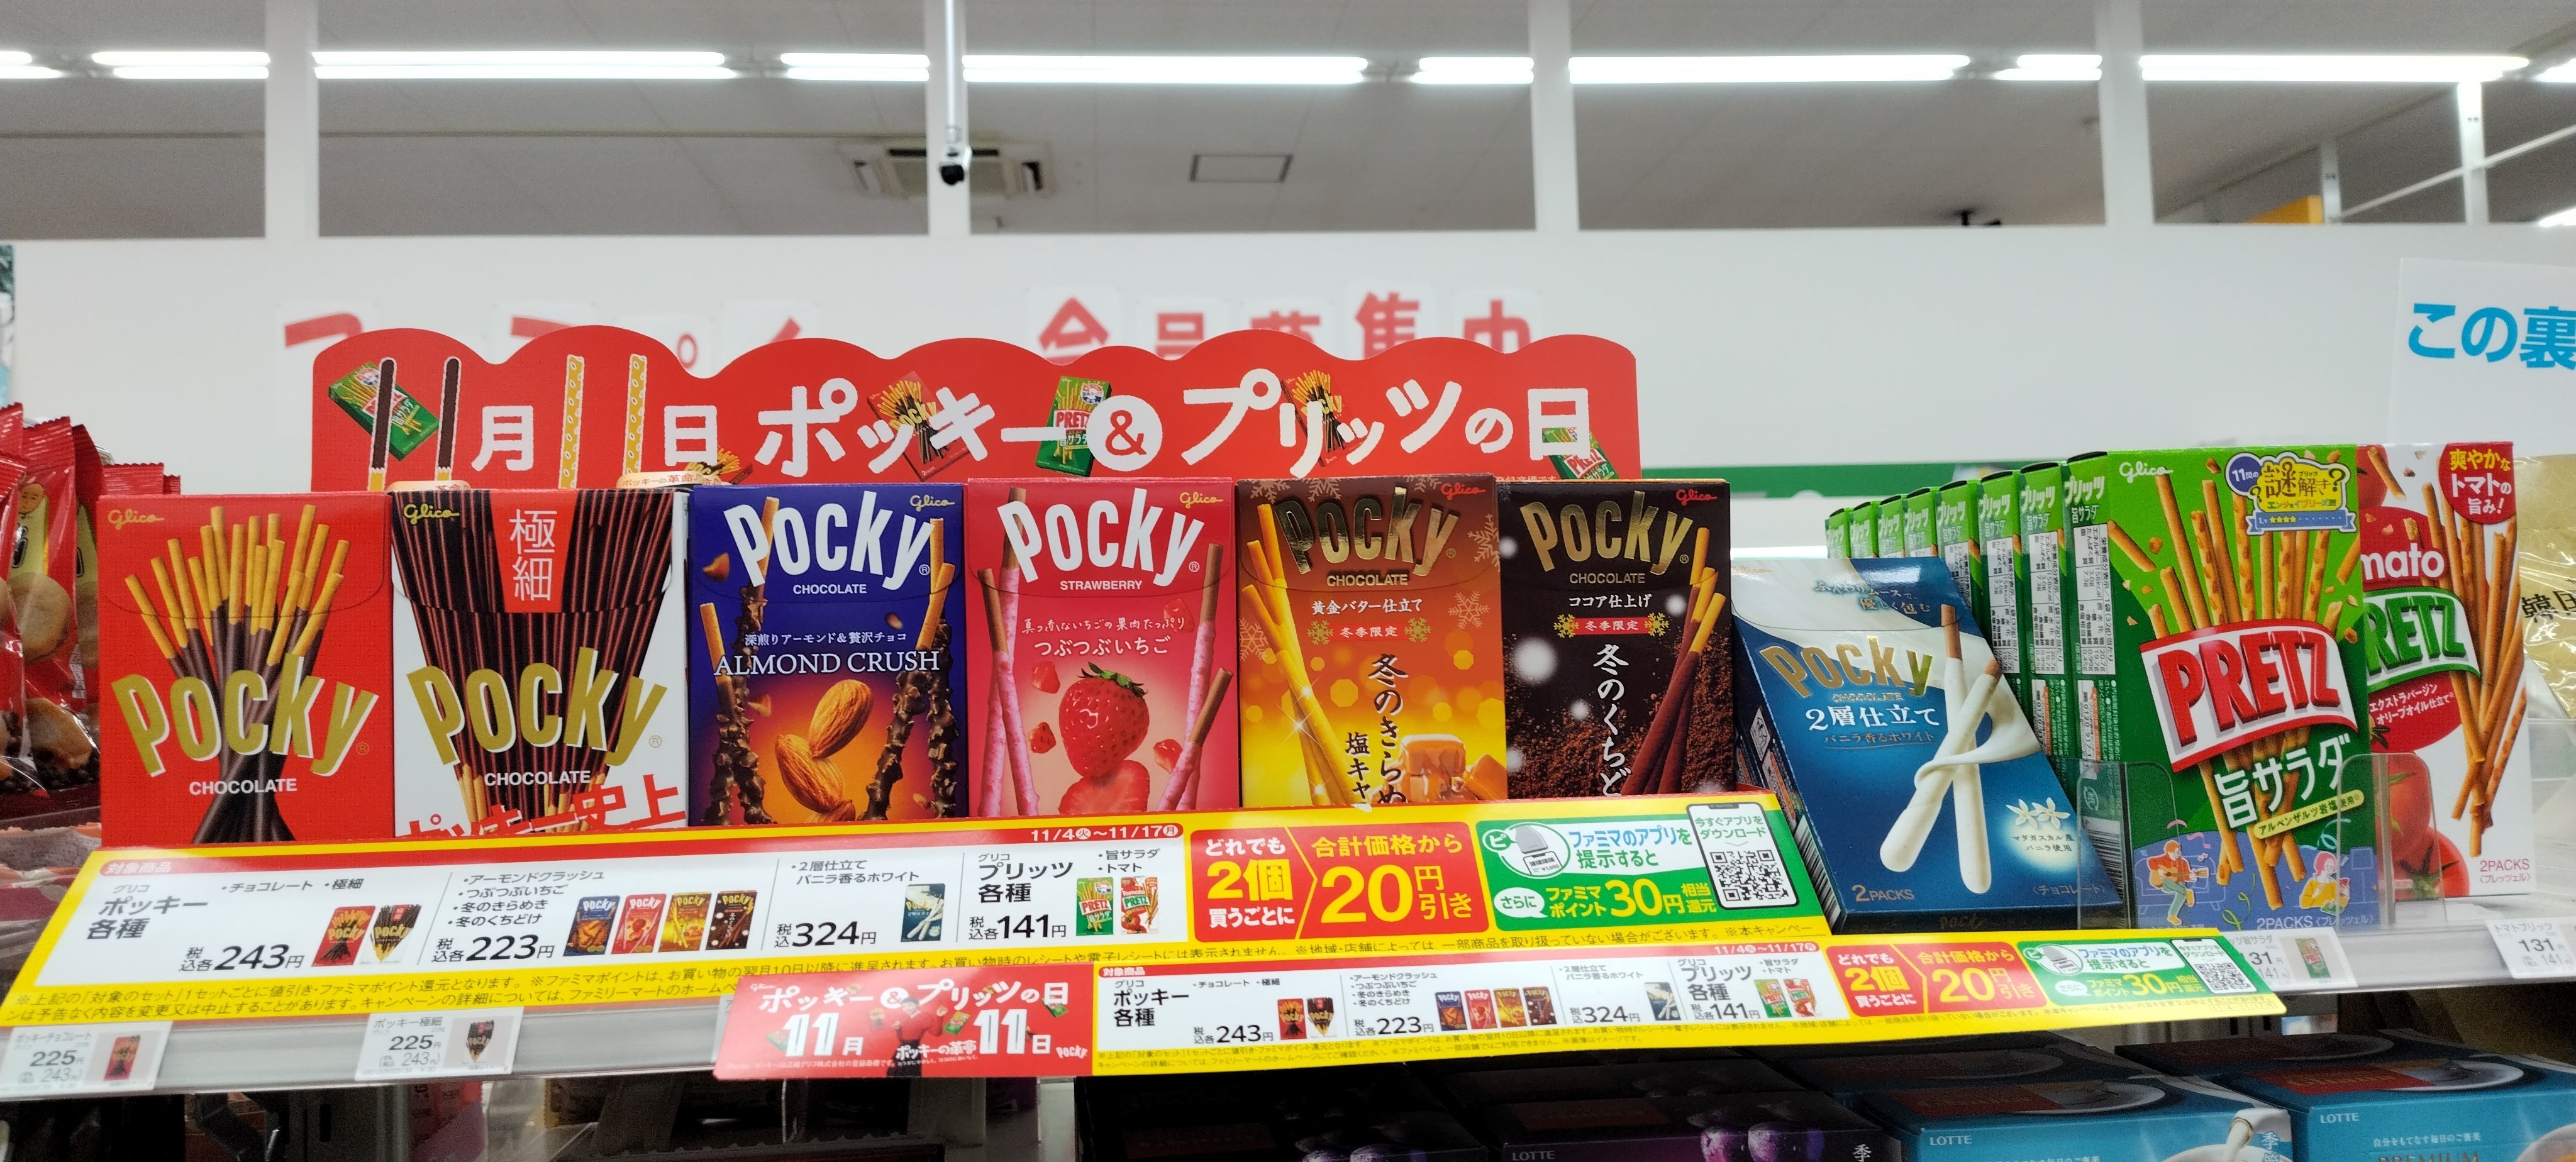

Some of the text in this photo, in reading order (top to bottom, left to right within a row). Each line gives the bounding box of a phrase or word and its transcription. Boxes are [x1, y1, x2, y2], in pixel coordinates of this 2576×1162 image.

[2408, 302, 2576, 370] この裏
[2449, 448, 2511, 472] 爽やかな
[2119, 461, 2173, 482] Glico
[1441, 482, 1487, 501] Glico
[2064, 475, 2106, 504] プリッツ
[2451, 472, 2512, 497] トマトの
[909, 495, 955, 511] Glico
[1179, 491, 1223, 508] Glico
[1675, 489, 1718, 507] Glico
[1979, 493, 2011, 520] プリッツ
[2020, 485, 2056, 512] プリッツ
[2468, 497, 2504, 515] 旨み!
[108, 509, 165, 532] Glico
[403, 504, 460, 525] Glico
[2071, 504, 2099, 524] 旨サラダ
[509, 509, 558, 602] 極細
[1060, 580, 1143, 591] STRAWBERRY
[1326, 573, 1409, 587] CHOCOLATE
[1569, 572, 1646, 585] CHOCOLATE
[793, 584, 867, 595] CHOCOLATE
[1311, 598, 1424, 616] 黄金バター仕立て
[1568, 593, 1653, 609] ココア仕上げ
[1339, 626, 1399, 639] 冬季限定
[1584, 619, 1640, 632] 冬季限定
[1033, 635, 1172, 657] つぶつぶいちご
[713, 650, 941, 676] ALMOND CRUSH
[1831, 692, 1904, 702] CHOCOLATE
[2155, 632, 2341, 746] PRETZ
[1592, 643, 1631, 798] 冬のくちど
[1805, 705, 1940, 731] 2層仕立て
[1346, 731, 1372, 805] 塩キャ
[189, 778, 297, 795] CHOCOLATE
[484, 770, 591, 787] CHOCOLATE
[2216, 734, 2351, 830] 旨サラダ
[1694, 816, 1763, 829] 今すぐアプリを
[1568, 827, 1693, 850] ファミマのアプリを
[1699, 826, 1767, 840] ダウンロード
[1204, 838, 1286, 857] どれでも
[1311, 833, 1463, 858] 合計価格から
[977, 853, 1011, 862] グリコ
[1576, 849, 1660, 869] 提示すると
[2480, 858, 2530, 872] 2PACKS
[796, 870, 920, 885] バニラ香るホワイト
[979, 861, 1074, 880] プリッツ
[1207, 858, 1294, 902] 2個
[113, 884, 150, 894] グリコ
[977, 883, 1032, 904] 各種
[1320, 864, 1414, 924] 20
[1545, 885, 1600, 902] ファミマ
[1680, 882, 1711, 899] 相当
[1852, 885, 1915, 902] 2PACKS
[98, 896, 209, 916] ポッキー
[1501, 895, 1537, 910] さらに
[1550, 896, 1718, 919] ポイント 還元
[1208, 905, 1296, 929] 買うごとに
[2257, 916, 2312, 930] 2PACKS
[86, 917, 150, 940] 各種
[1677, 958, 1707, 966] グリコ
[1836, 952, 1895, 966] どれでも
[1915, 948, 2016, 966] 合計価格から
[2079, 945, 2172, 960] ファミマのアプリを
[2087, 957, 2151, 970] 提示すると
[1681, 965, 1752, 983] プリッツ
[1844, 968, 1911, 992] 2個
[1115, 980, 1145, 988] グリコ
[1688, 983, 1731, 1002] 各種
[1931, 967, 1994, 1003] 20
[1113, 989, 1190, 1007] ポッキー
[1855, 992, 1918, 1009] 買うごとに
[1113, 1008, 1156, 1028] 各種
[2321, 1112, 2360, 1124] LOTTE
[1929, 1135, 1973, 1146] LOTTE
